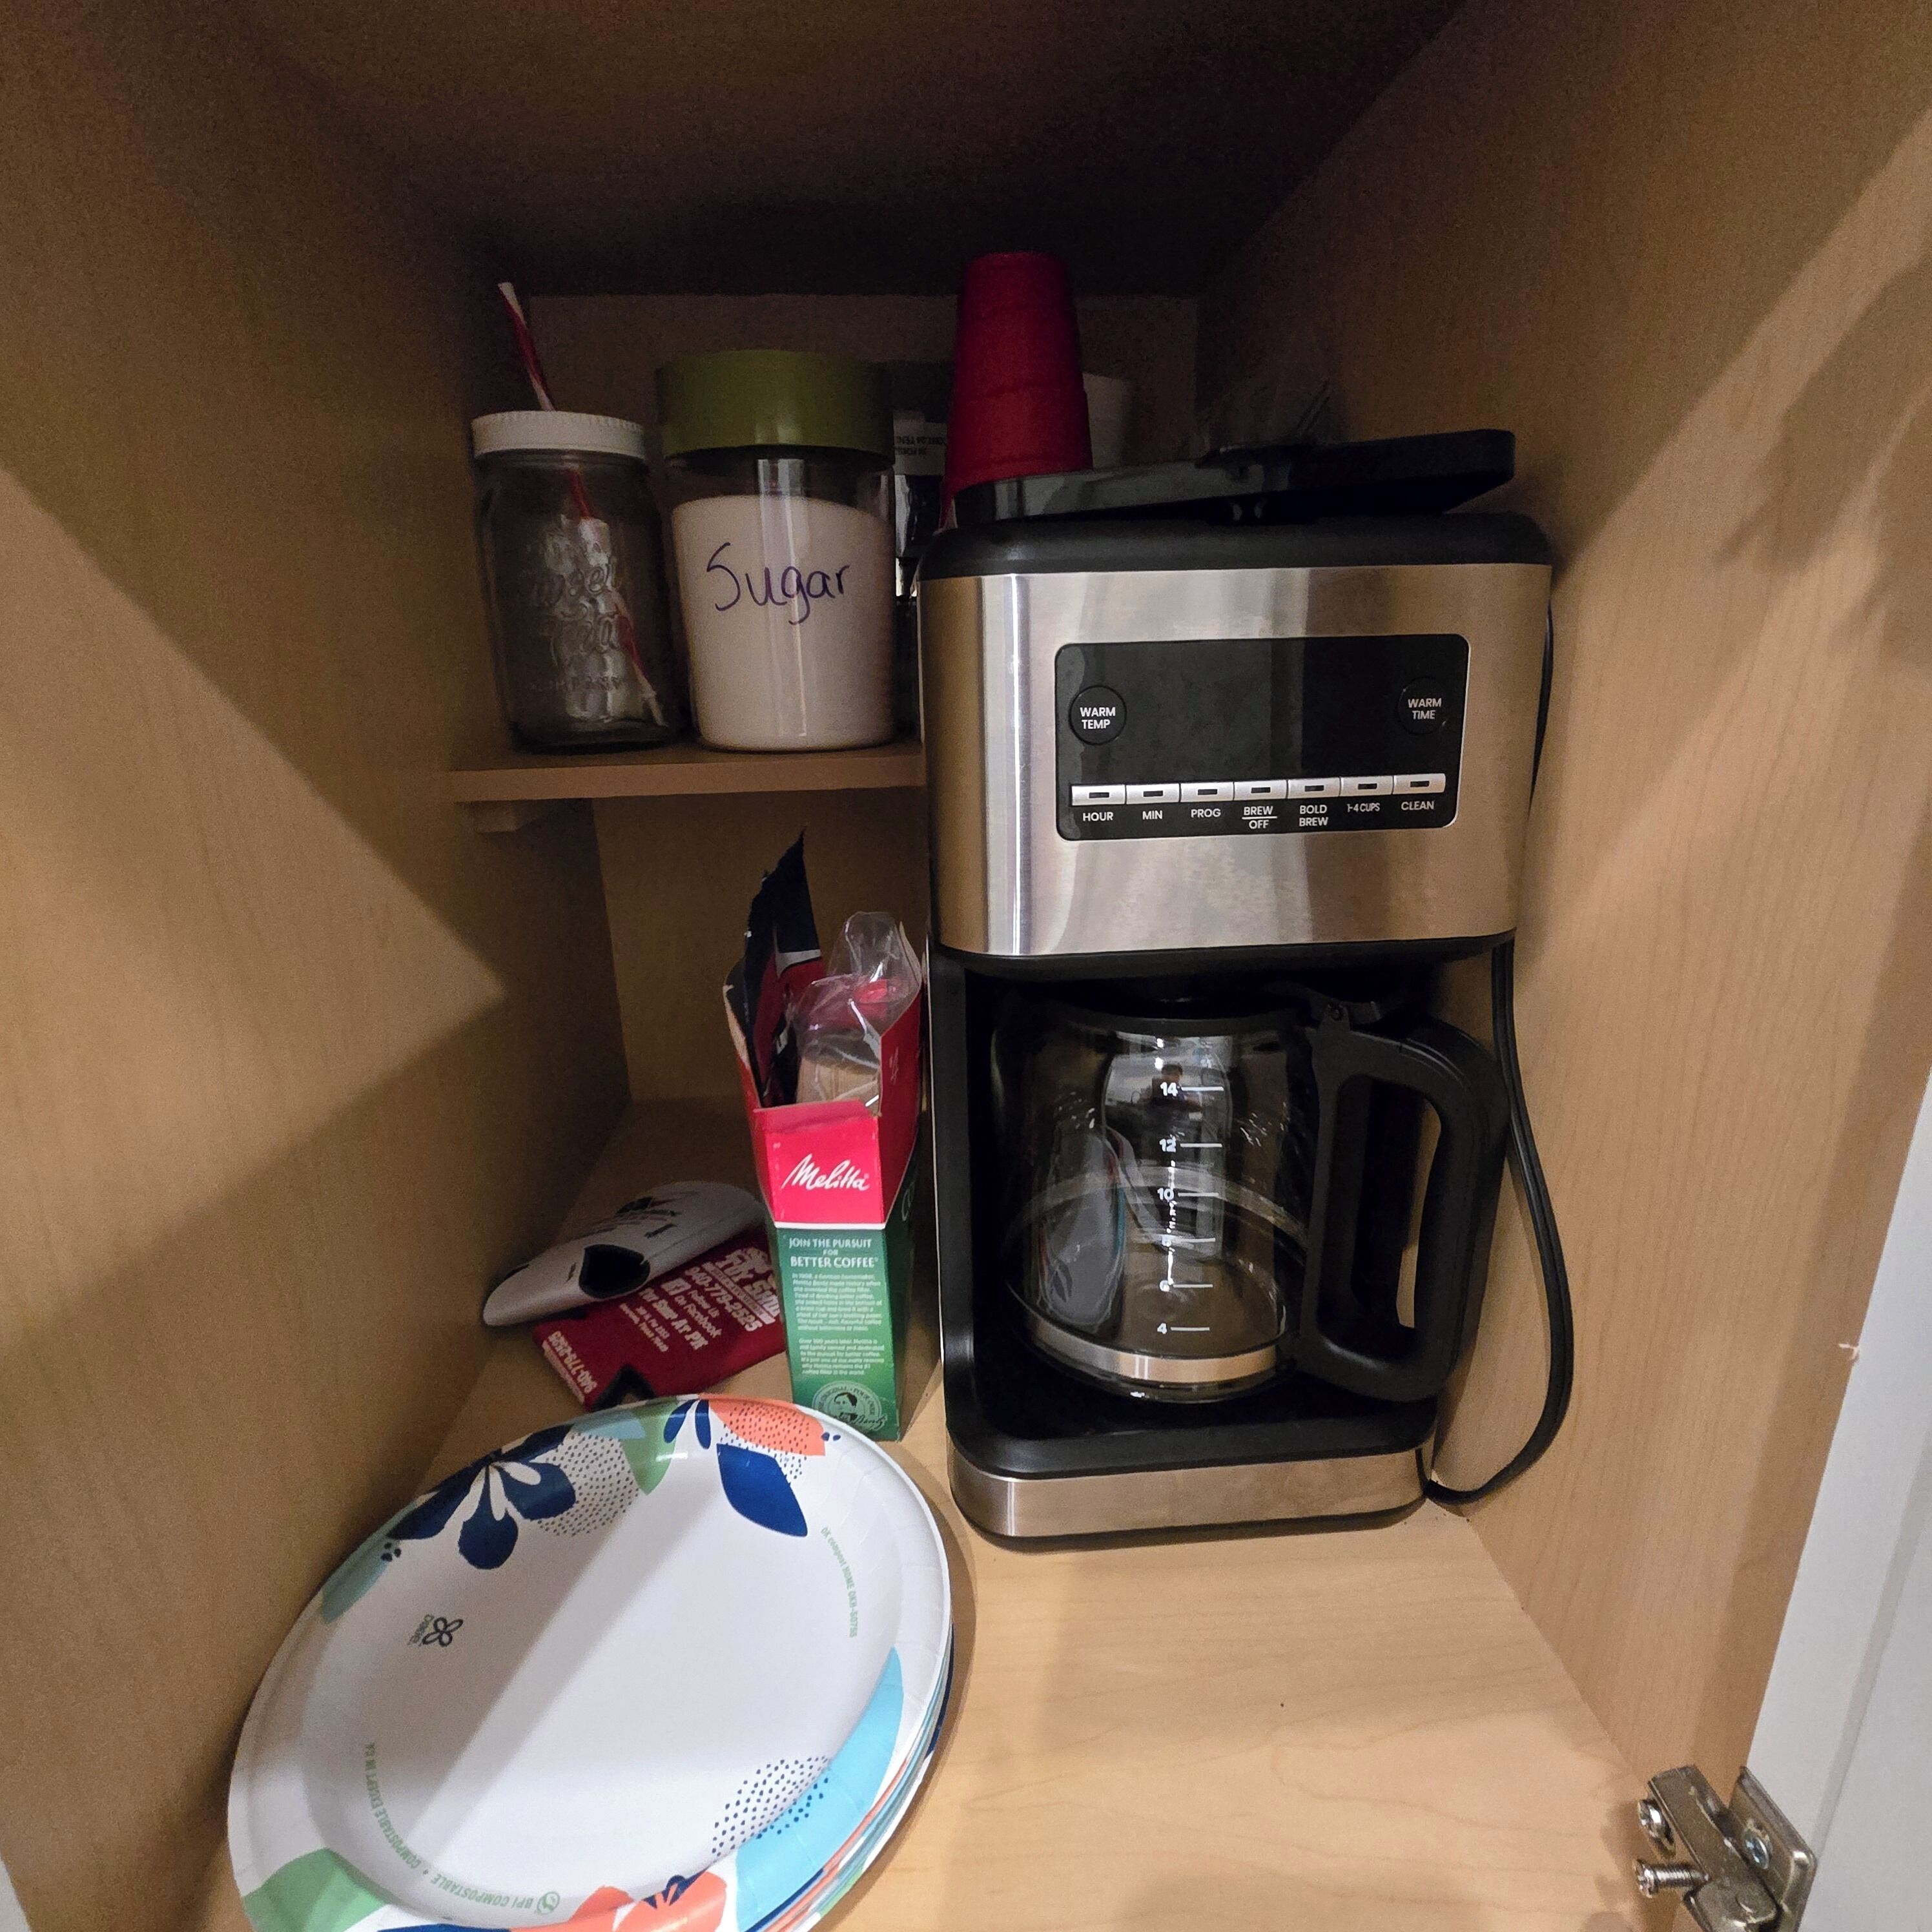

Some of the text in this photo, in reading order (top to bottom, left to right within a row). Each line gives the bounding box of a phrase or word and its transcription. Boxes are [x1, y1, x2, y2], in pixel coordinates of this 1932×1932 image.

[706, 542, 850, 625] Sugar
[1408, 698, 1442, 708] WARM
[1080, 706, 1116, 717] WARM
[1412, 710, 1435, 720] TIME
[1082, 719, 1111, 730] TEMP
[1243, 806, 1273, 816] BREW
[1299, 805, 1328, 814] BOLD
[1359, 803, 1381, 812] CUPS
[1401, 801, 1435, 811] CLEAN
[1082, 812, 1113, 822] HOUR
[1142, 810, 1162, 820] MIN
[1191, 808, 1221, 818] PROG
[1249, 819, 1269, 829] OFF
[1299, 817, 1329, 827] BREW
[1160, 1082, 1178, 1096] 14
[1160, 1136, 1177, 1152] 12
[781, 1153, 870, 1191] Melitta
[1157, 1187, 1175, 1200] 10
[789, 1237, 872, 1249] JOIN THE PURSUIT
[790, 1256, 875, 1268] BETTER COFFEE
[684, 1266, 763, 1332] 940-779-2525
[683, 1303, 723, 1339] Facebook
[1156, 1324, 1167, 1334] 4
[842, 1565, 855, 1590] HOME
[365, 1771, 384, 1809] EXCEPT
[375, 1807, 422, 1869] COMPOSTABLE
[431, 1873, 510, 1908] COMPOSTABLE
[511, 1895, 534, 1909] BPI
